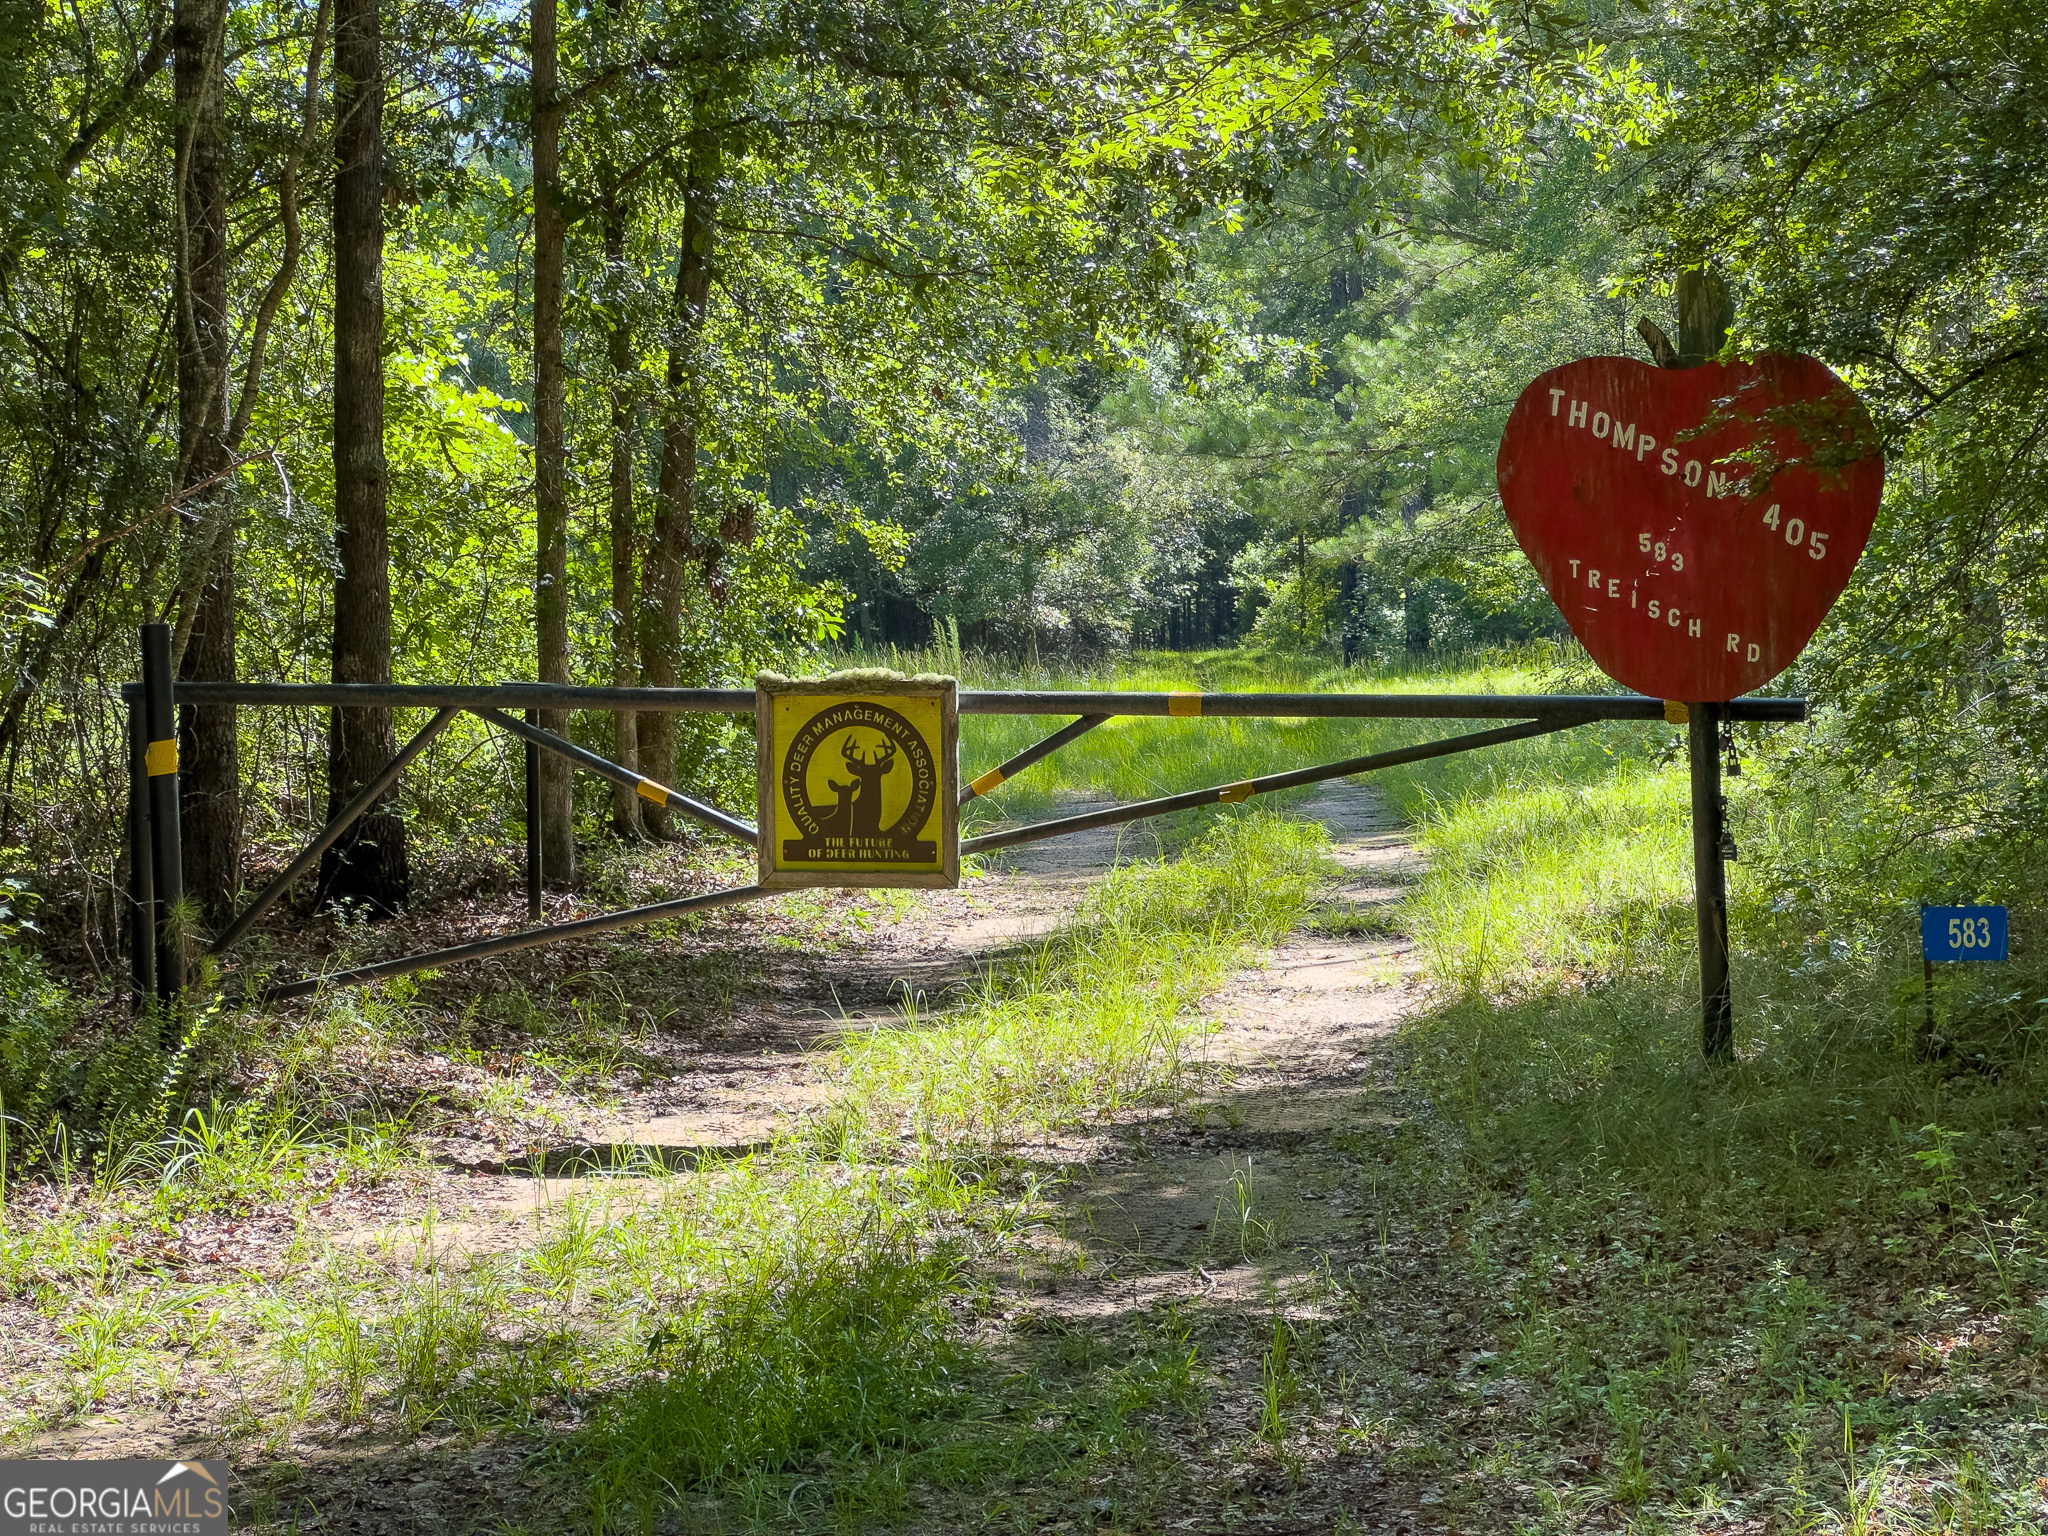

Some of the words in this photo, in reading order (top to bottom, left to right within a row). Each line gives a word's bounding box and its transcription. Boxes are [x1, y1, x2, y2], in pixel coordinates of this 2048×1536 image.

[1762, 504, 1829, 560] 405
[1638, 533, 1684, 572] 583
[1568, 559, 1701, 638] TREISCH
[1726, 633, 1760, 663] RD
[811, 709, 911, 739] MANAGEMENT
[790, 733, 815, 773] DEER
[789, 775, 820, 835] QUALITY
[900, 739, 930, 837] ASSOCIATION
[808, 848, 823, 859] OF
[826, 848, 856, 859] DEER
[859, 849, 910, 860] HUNTING
[824, 837, 845, 848] THE
[850, 837, 893, 848] FUTURE
[1948, 917, 1991, 949] 583
